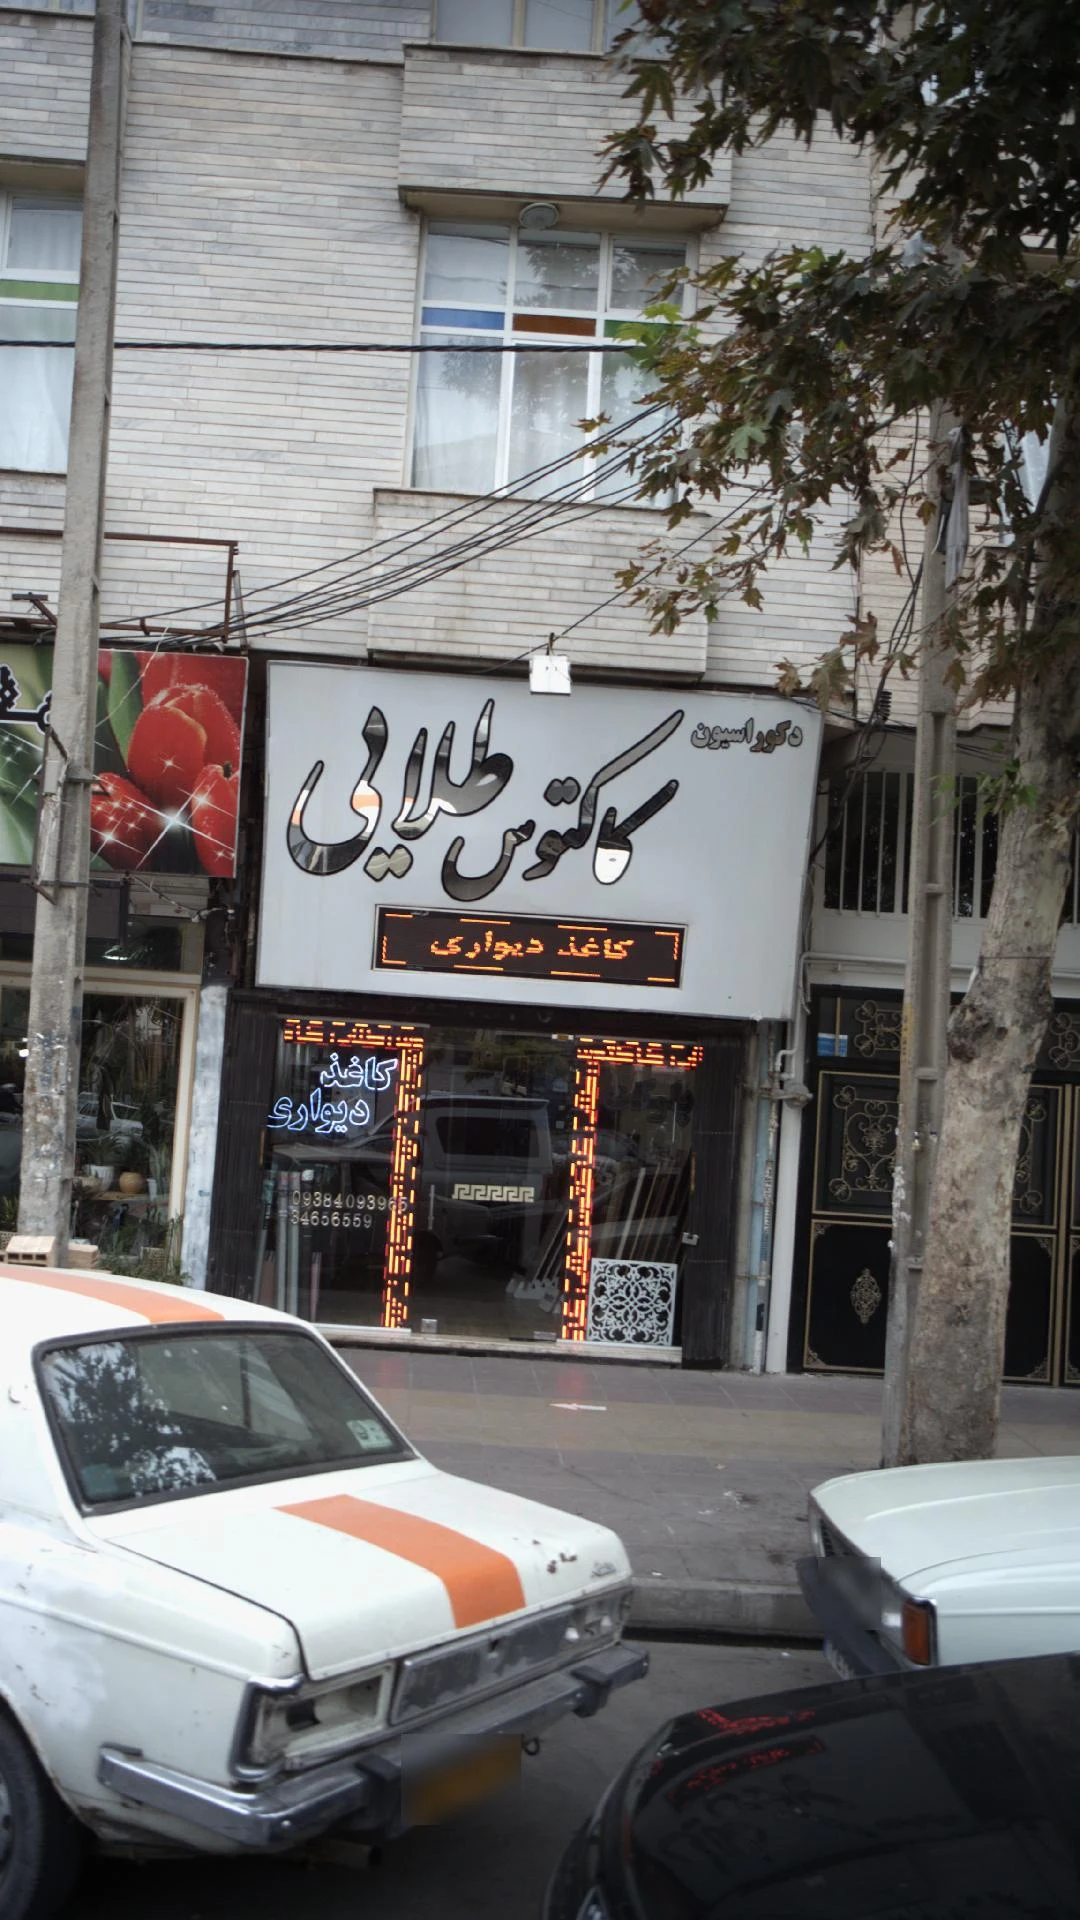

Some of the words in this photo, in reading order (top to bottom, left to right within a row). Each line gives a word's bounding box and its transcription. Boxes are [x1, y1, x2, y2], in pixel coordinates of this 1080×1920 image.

[690, 717, 804, 754] دکوراسیون
[440, 709, 685, 902] کاکتوس
[430, 929, 545, 962] دیواری
[557, 936, 635, 961] کاغذ
[319, 1052, 399, 1092] کاغذ
[266, 1087, 371, 1134] دیواری
[289, 1208, 373, 1229] 34656559
